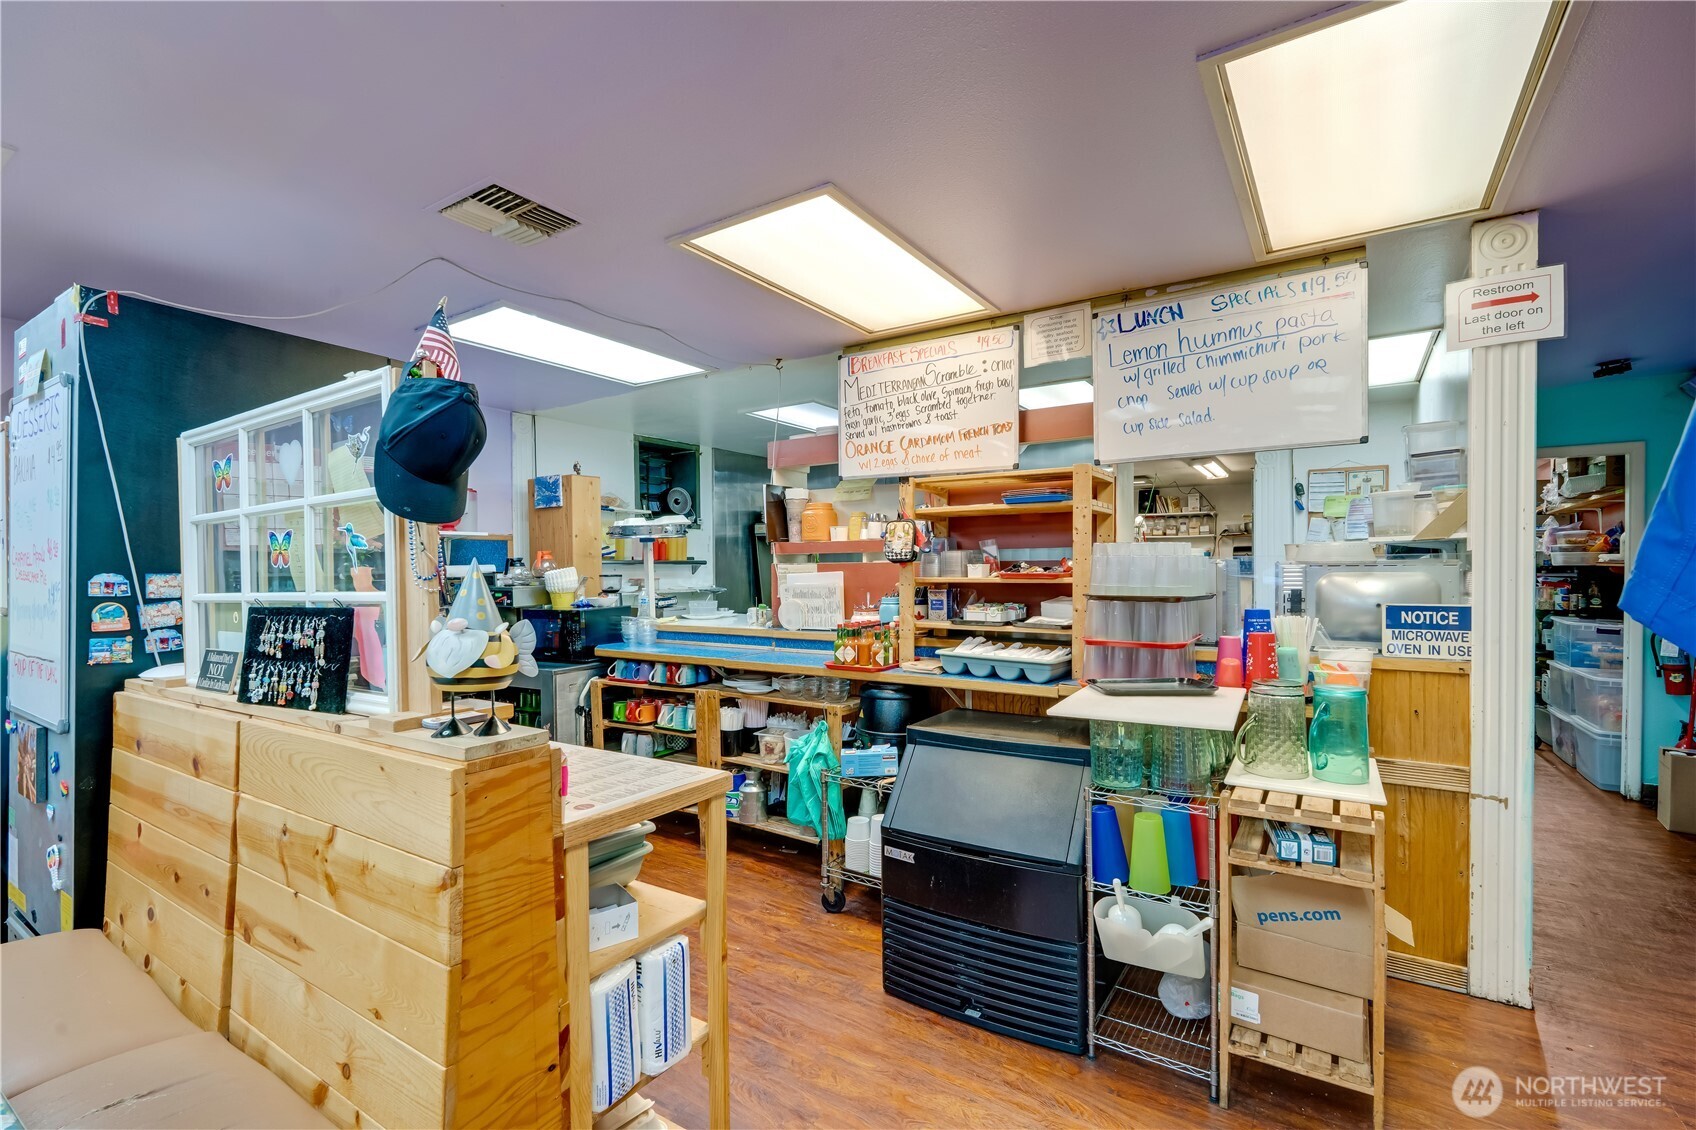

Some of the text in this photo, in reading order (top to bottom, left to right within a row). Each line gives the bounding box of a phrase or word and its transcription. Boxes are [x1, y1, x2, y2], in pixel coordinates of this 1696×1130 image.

[1472, 281, 1535, 298] Restroom
[1117, 302, 1184, 333] LUNCH
[1210, 281, 1297, 313] SPECIALS
[1464, 306, 1543, 325] Last door on
[1108, 307, 1336, 367] Lemon hummus pasta
[1482, 321, 1525, 335] the left
[910, 341, 958, 364] SPECIALS
[1143, 356, 1186, 386] grilled
[1299, 329, 1352, 354] pork
[924, 362, 978, 387] Scramble
[897, 391, 921, 407] black
[16, 392, 60, 440] DESSERTS
[895, 408, 911, 422] eggs
[934, 408, 959, 422] toast
[845, 440, 897, 459] ORANGE
[899, 431, 956, 451] CARDAMOM
[957, 425, 990, 442] FRENCH
[873, 457, 881, 469] 2
[881, 457, 899, 470] eggs
[939, 447, 950, 462] of
[953, 444, 983, 460] meat
[1400, 610, 1459, 625] NOTICE
[1391, 630, 1470, 643] MICROWAVE
[1386, 643, 1422, 654] OVEN
[1428, 644, 1441, 656] IN
[207, 663, 228, 677] NOT
[1256, 908, 1342, 926] pens.com
